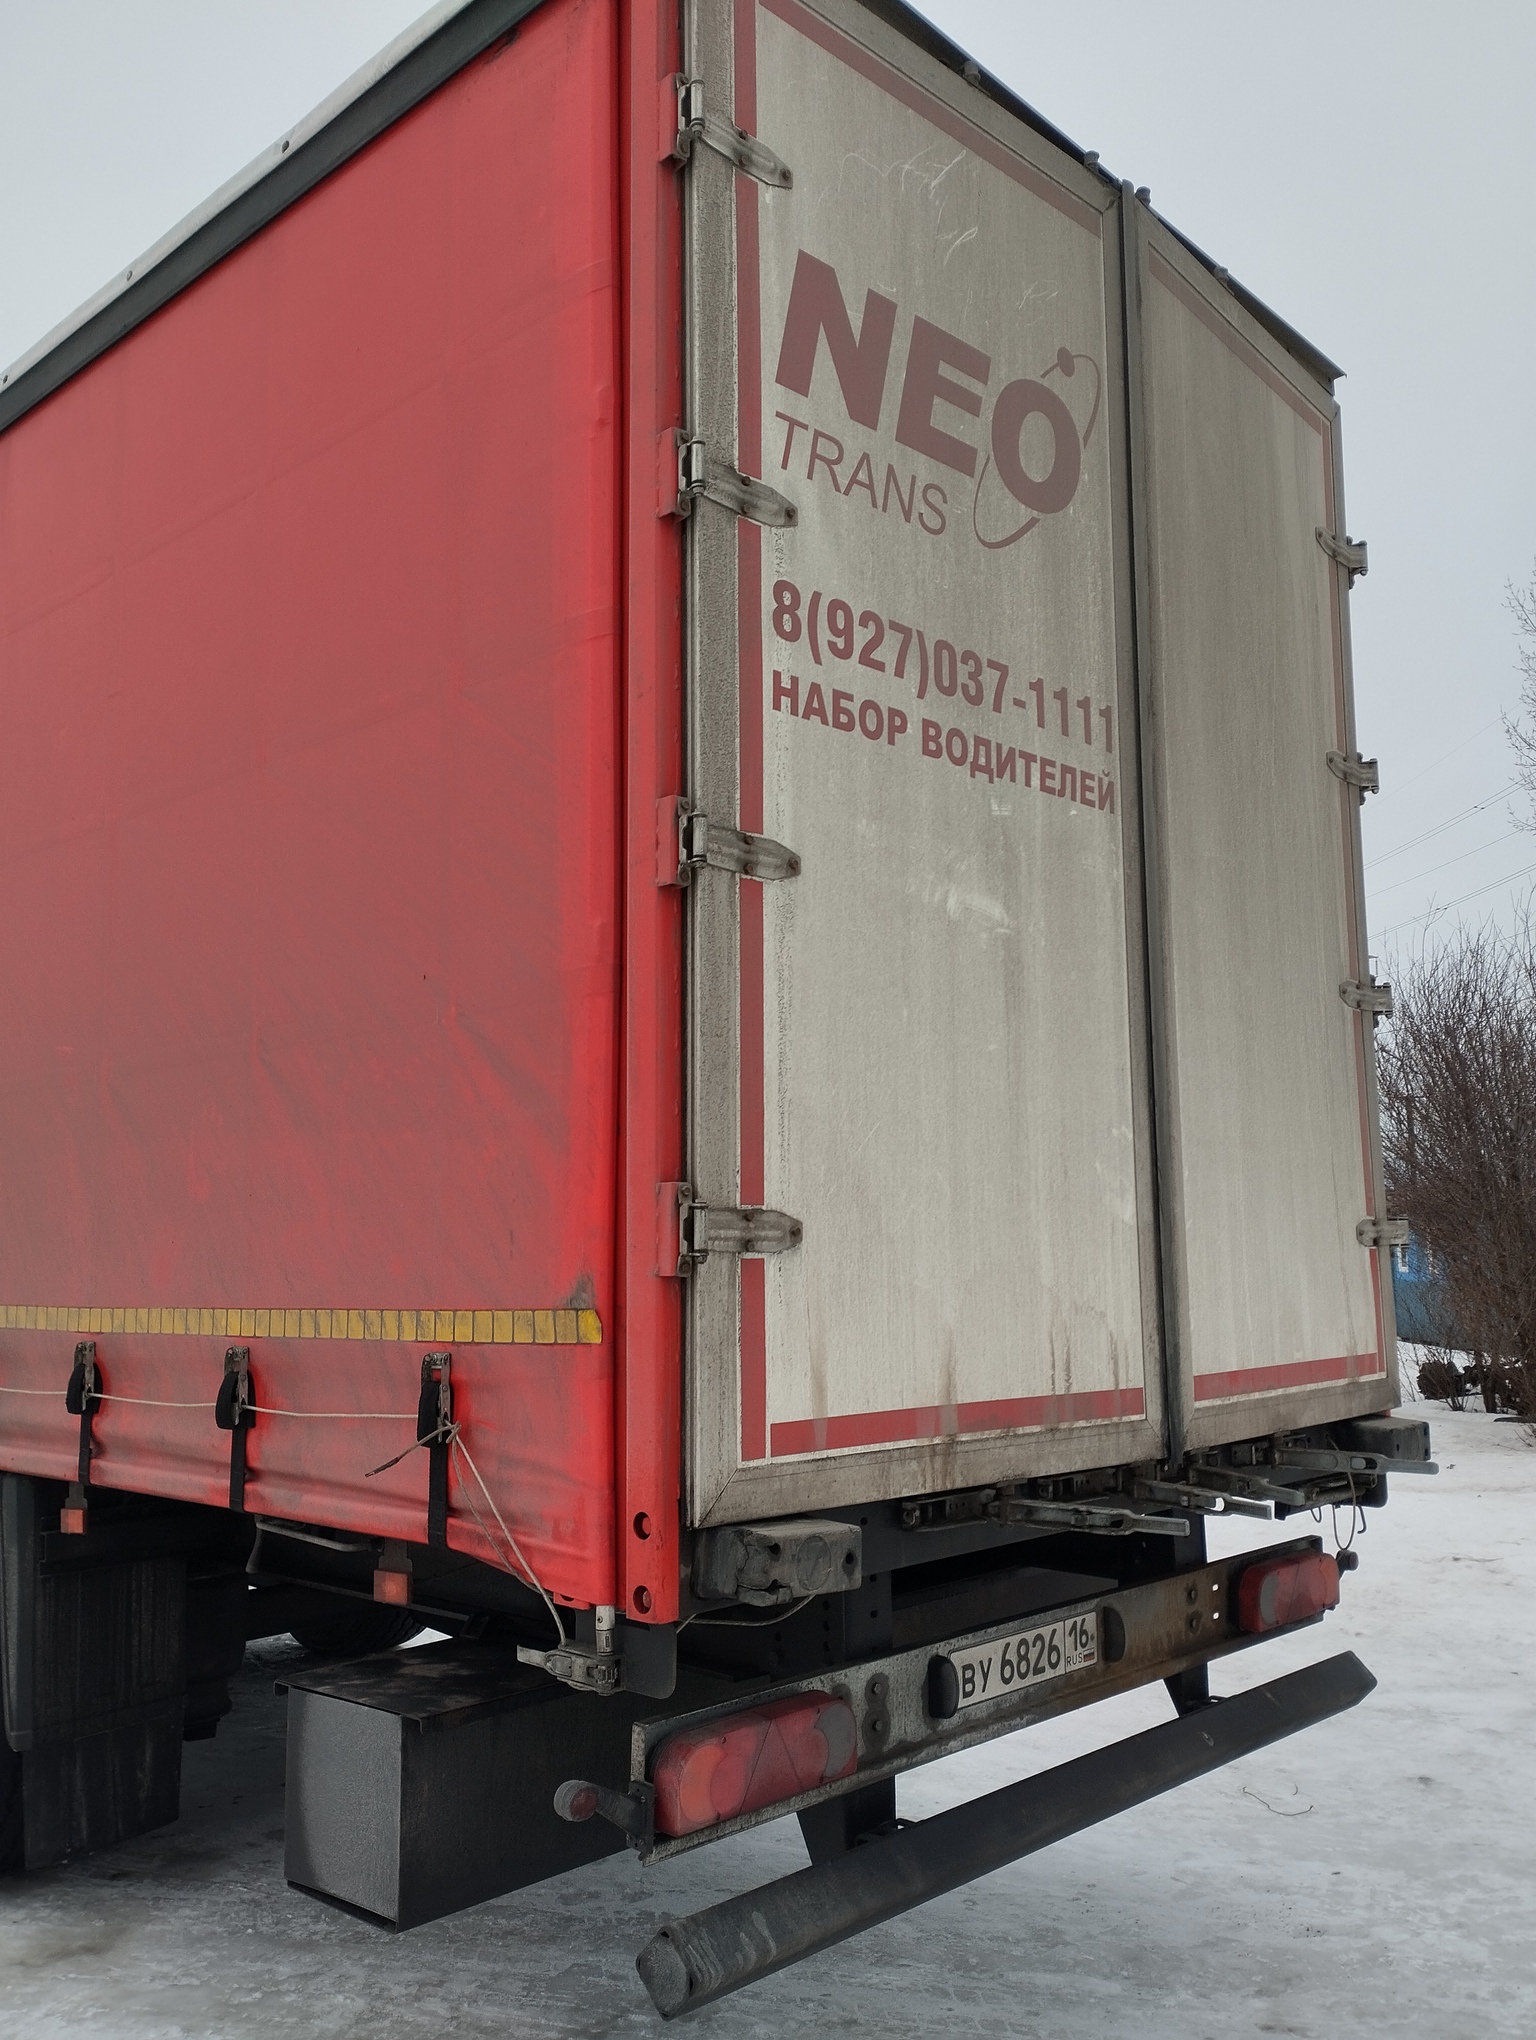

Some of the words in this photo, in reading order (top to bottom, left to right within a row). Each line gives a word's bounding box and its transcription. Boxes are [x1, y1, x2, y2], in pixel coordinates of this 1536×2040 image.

[775, 249, 1082, 515] NEO
[775, 410, 948, 536] TRANS
[772, 579, 1113, 754] 8(927)037-1111
[772, 669, 909, 747] НАБОР
[921, 717, 1115, 815] ВОДИТЕЛЕЙ
[1000, 1628, 1061, 1686] 6826
[1068, 1617, 1090, 1652] 16
[1066, 1652, 1083, 1668] RUS
